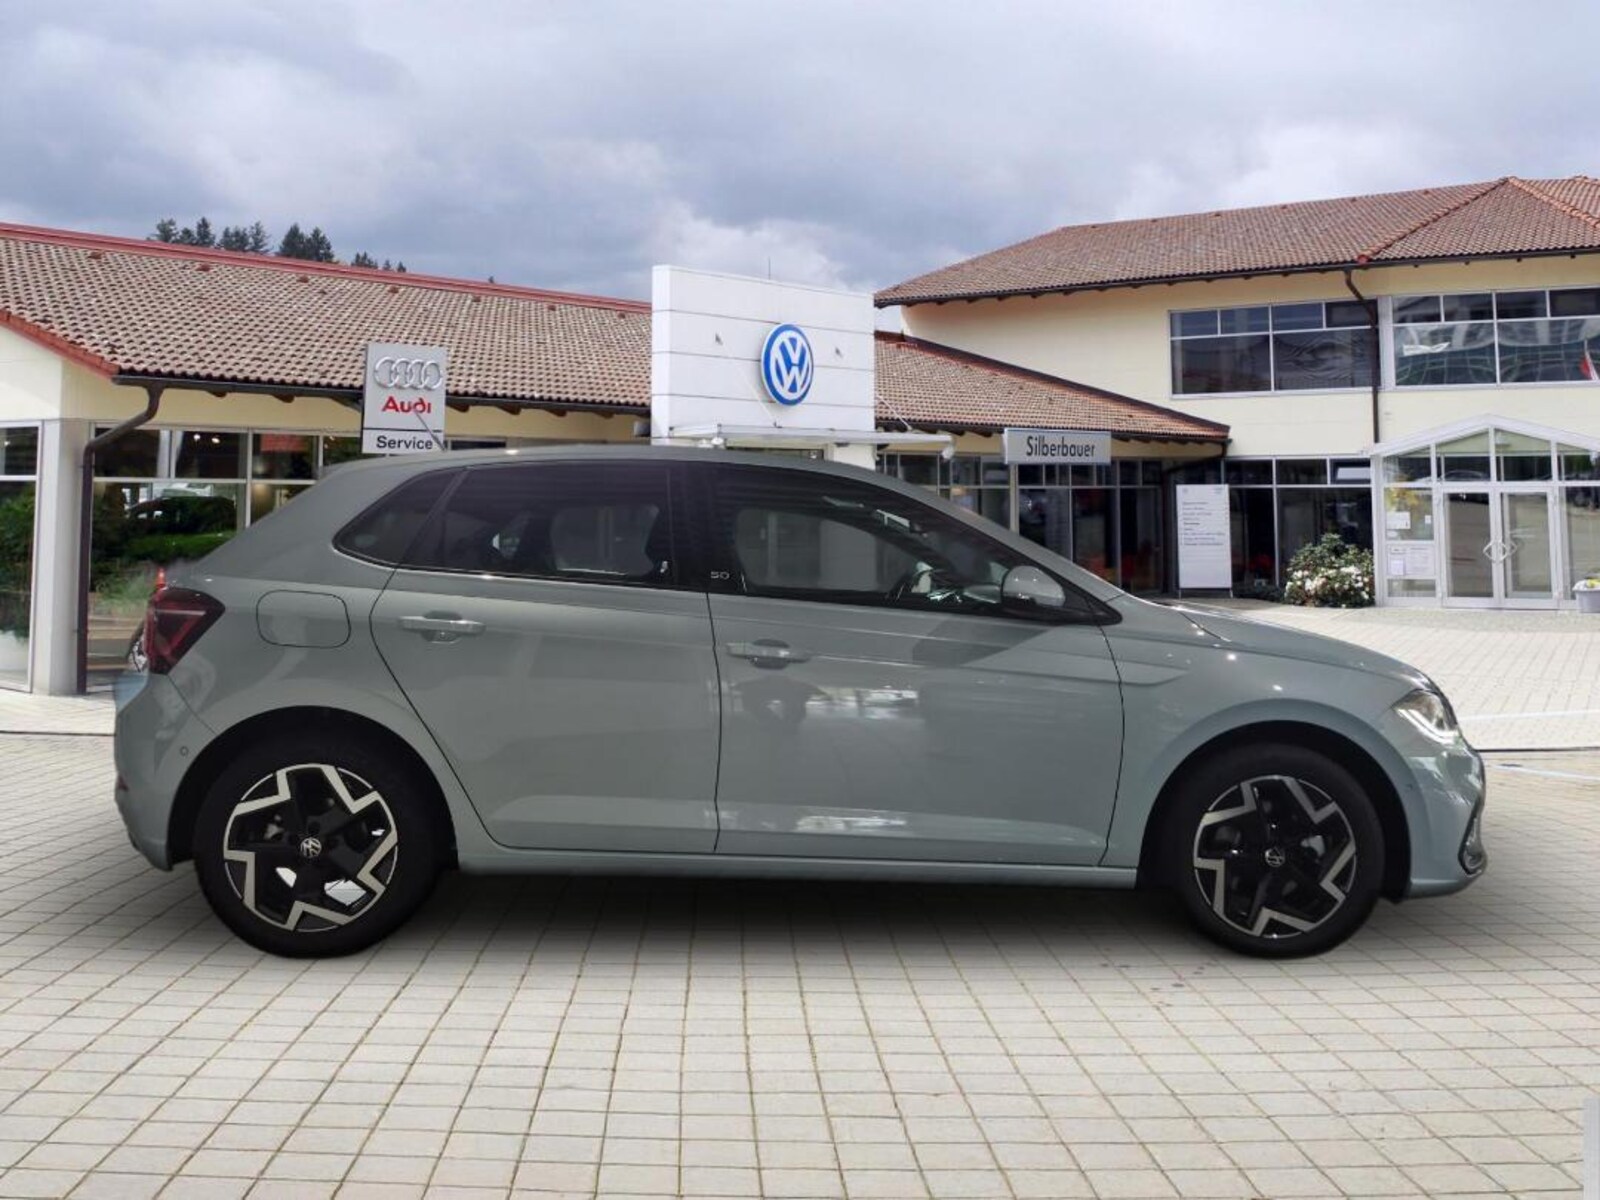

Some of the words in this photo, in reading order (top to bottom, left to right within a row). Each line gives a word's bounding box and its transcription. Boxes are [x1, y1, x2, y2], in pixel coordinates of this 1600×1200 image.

[382, 395, 432, 414] Audi
[376, 435, 433, 449] Service
[1026, 435, 1095, 457] Silberbauer
